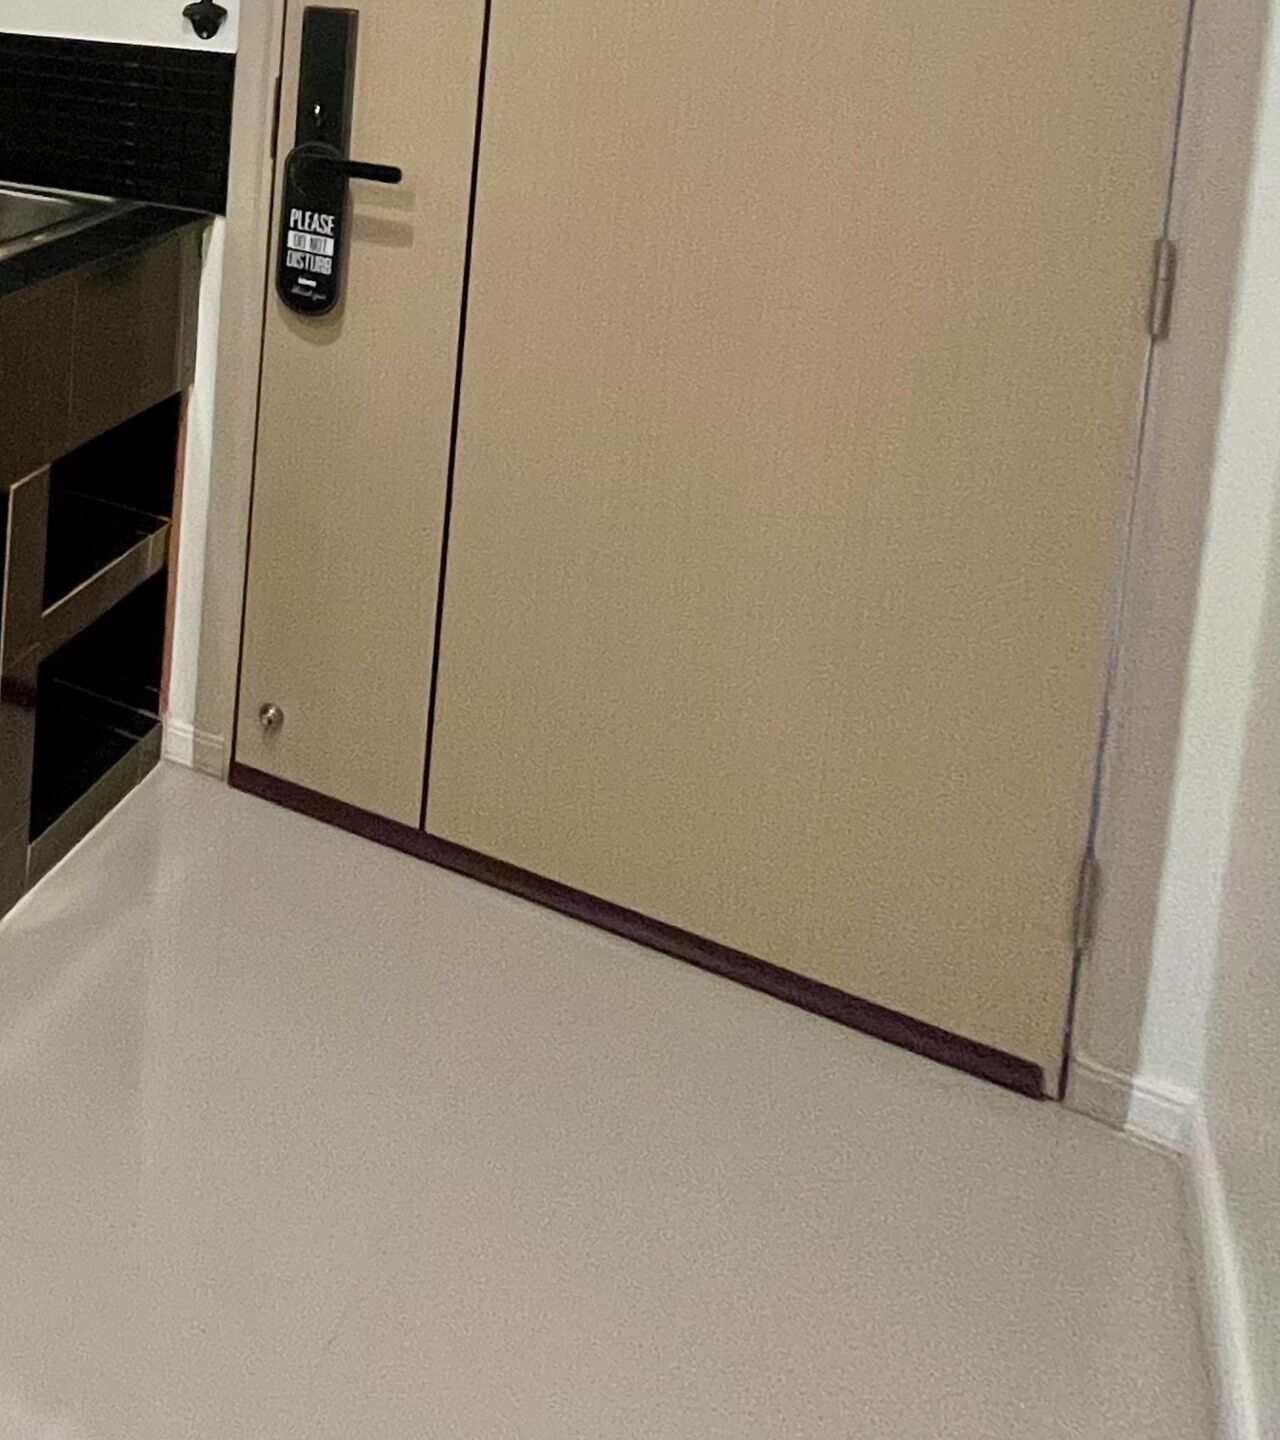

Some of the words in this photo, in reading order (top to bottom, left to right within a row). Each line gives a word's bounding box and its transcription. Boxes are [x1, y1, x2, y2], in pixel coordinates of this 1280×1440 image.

[289, 208, 335, 236] PLEASE
[293, 233, 307, 250] DO
[309, 236, 328, 253] NOT
[286, 249, 333, 275] DISTURB
